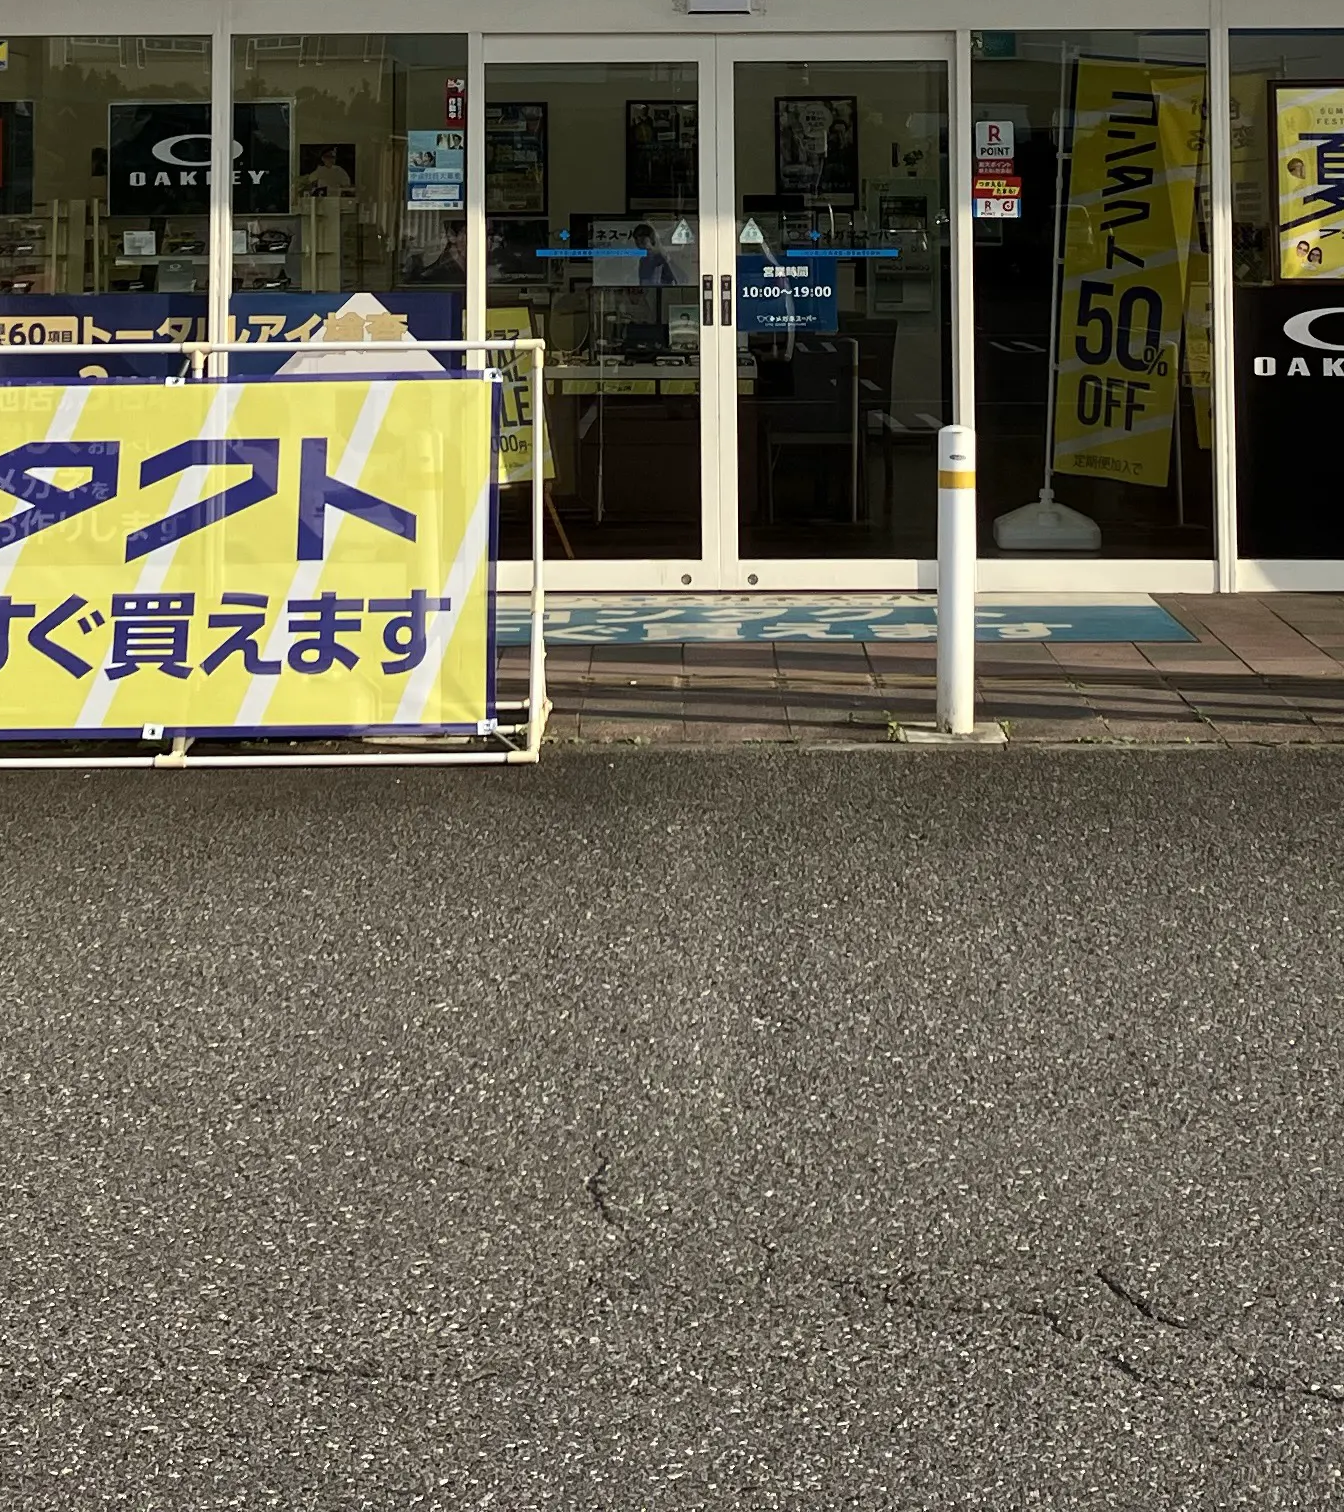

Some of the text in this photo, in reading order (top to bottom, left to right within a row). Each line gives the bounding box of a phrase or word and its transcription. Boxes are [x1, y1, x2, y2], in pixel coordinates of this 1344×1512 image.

[980, 147, 1011, 156] POINT
[129, 170, 267, 188] OAKEY
[1075, 374, 1150, 432] OFF
